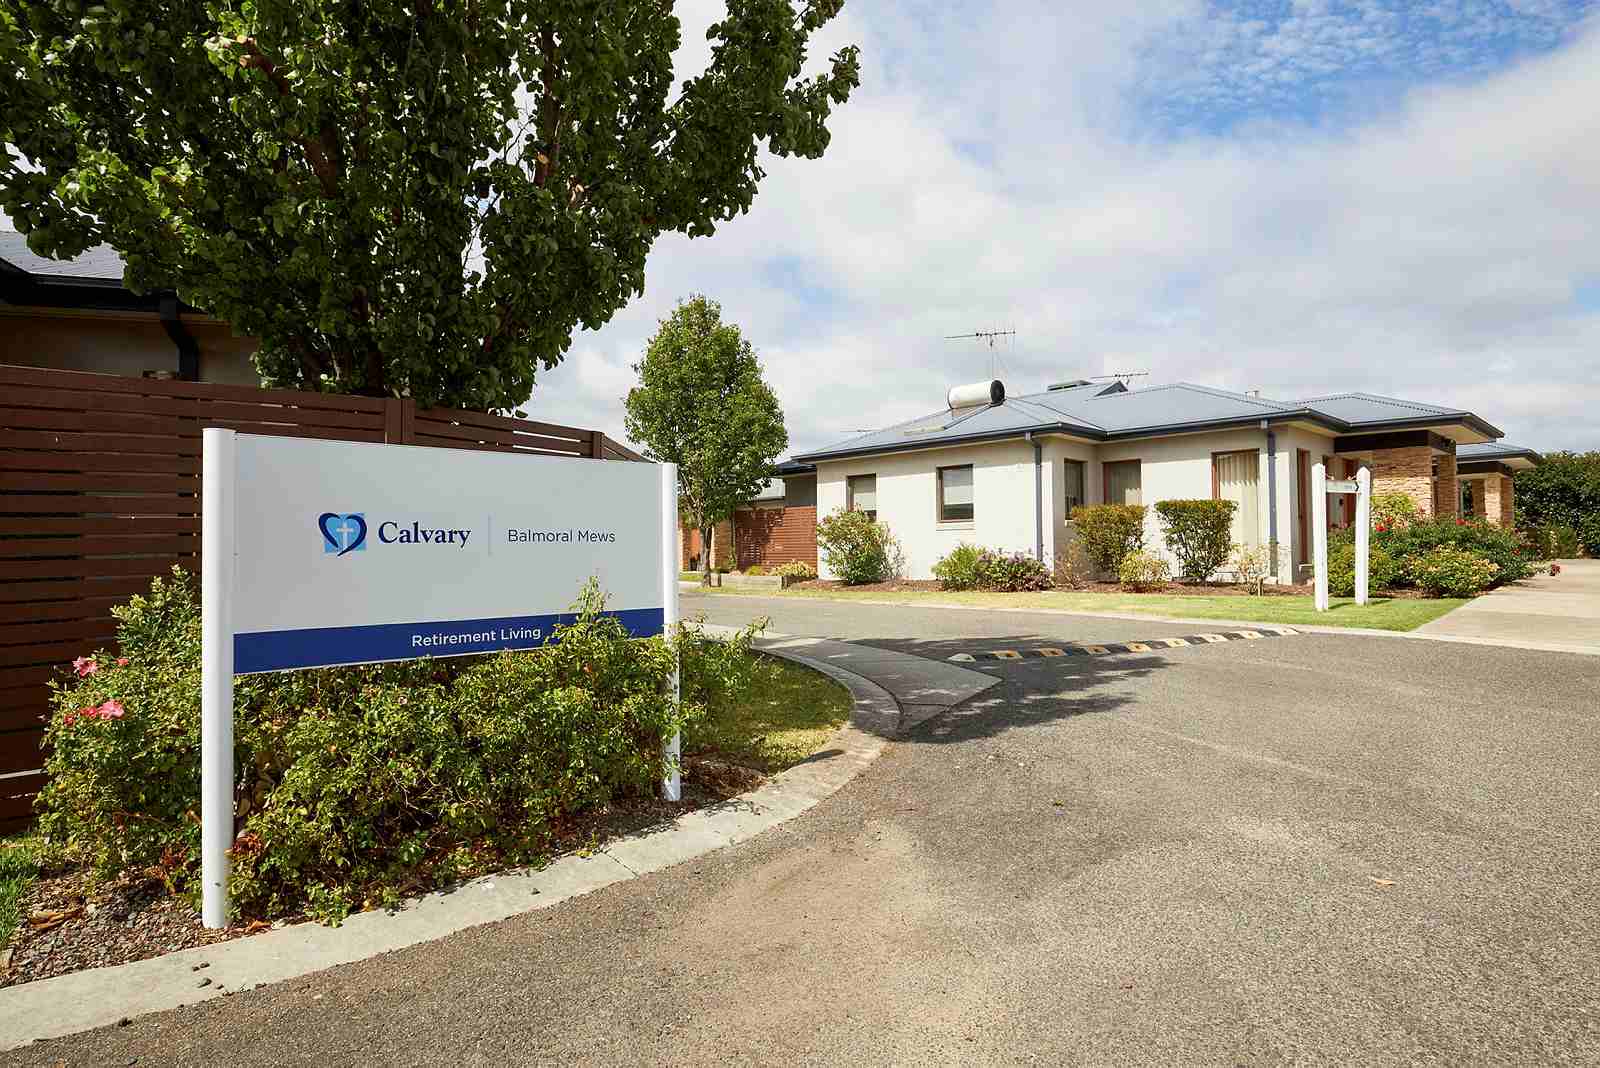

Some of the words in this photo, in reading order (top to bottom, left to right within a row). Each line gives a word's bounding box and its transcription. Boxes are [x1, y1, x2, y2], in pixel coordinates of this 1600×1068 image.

[378, 521, 471, 548] Calvary
[508, 529, 573, 542] Balmoral
[578, 530, 616, 542] Mews
[412, 630, 497, 647] Retirement
[501, 627, 541, 640] Living
